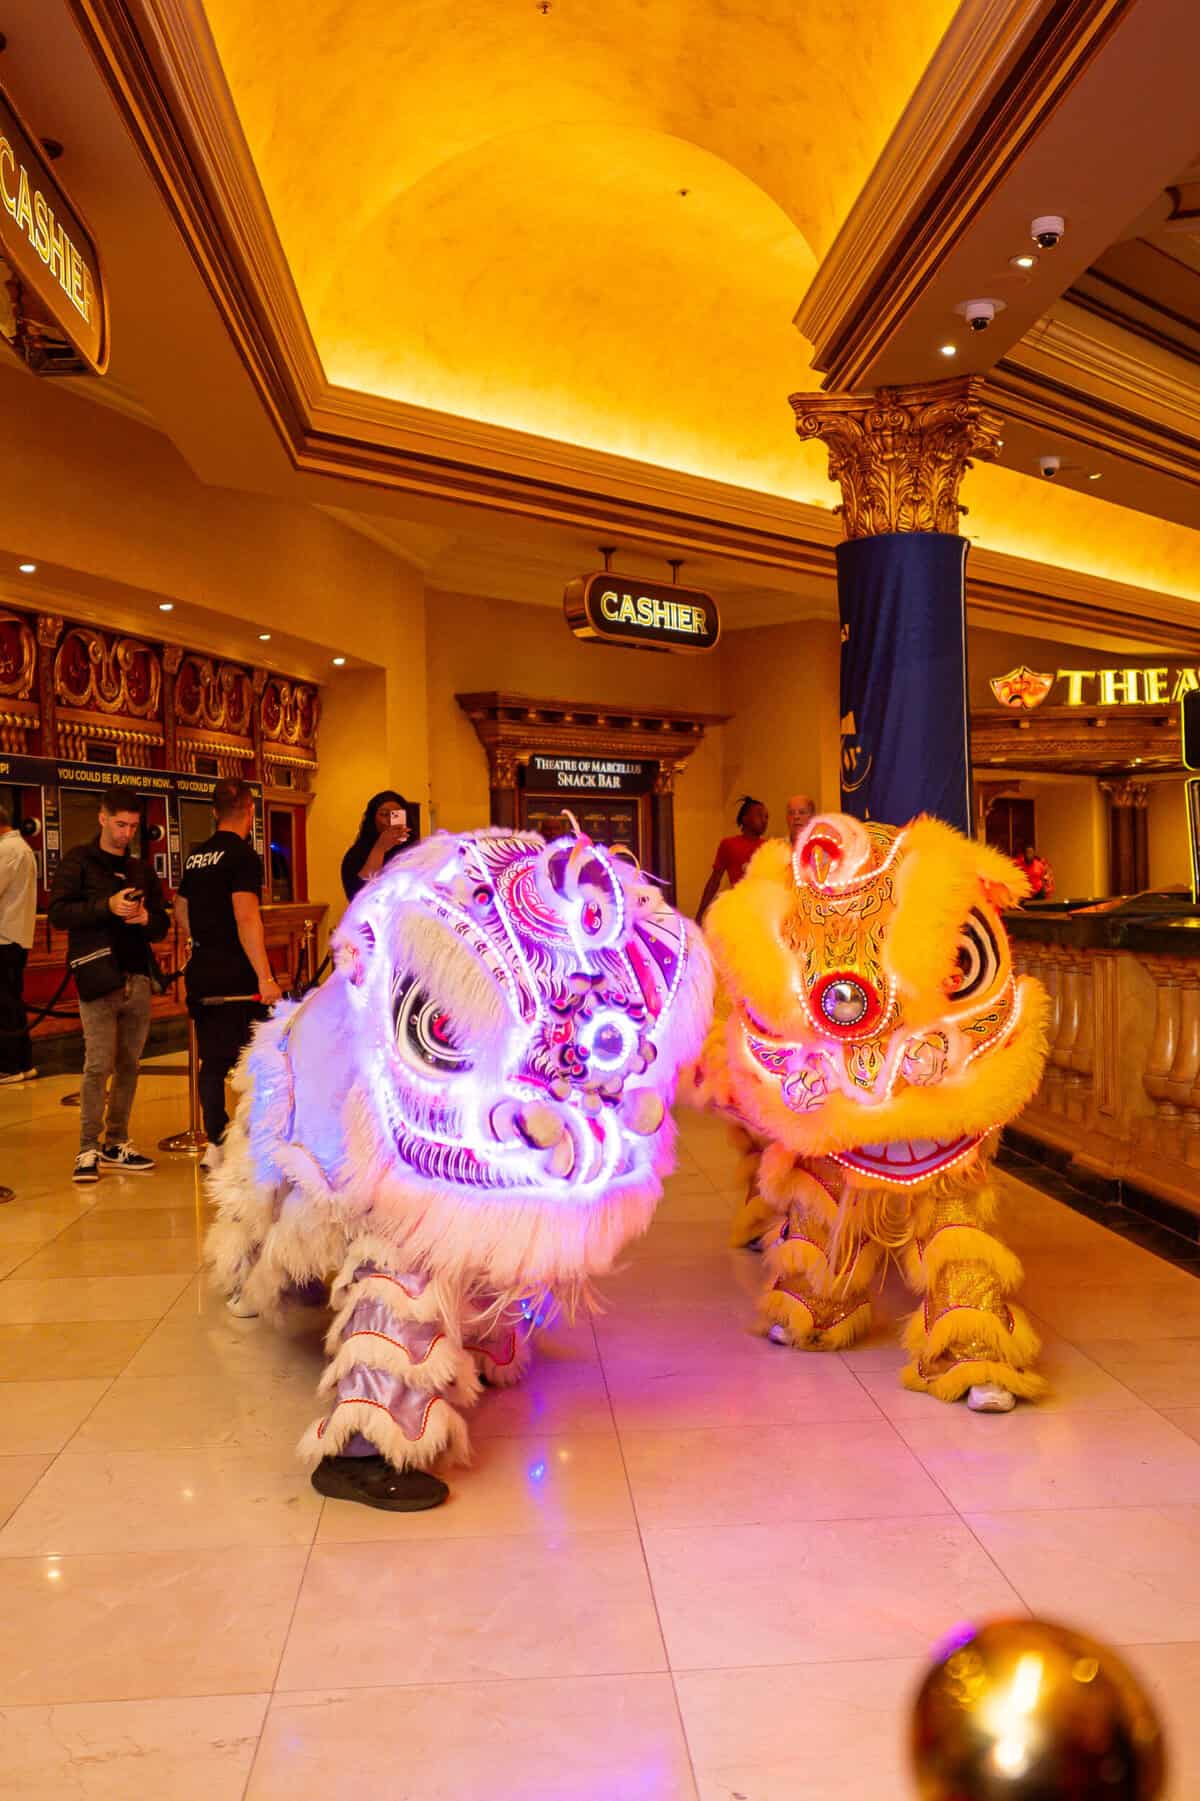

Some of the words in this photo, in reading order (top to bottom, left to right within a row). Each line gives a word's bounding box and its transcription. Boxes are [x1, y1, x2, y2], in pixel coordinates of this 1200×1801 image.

[0, 136, 95, 325] CASHIER
[600, 591, 708, 635] CASHIER
[1056, 668, 1200, 705] THEA
[534, 757, 577, 772] THEATRE
[578, 761, 591, 772] OF
[591, 760, 642, 774] MARCELLUS
[57, 767, 74, 780] YOU
[75, 769, 101, 783] COULD
[102, 772, 112, 784] BE
[112, 773, 142, 786] PLAYING
[142, 775, 152, 787] BY
[176, 780, 189, 791] YOU
[189, 781, 209, 792] COULD
[557, 771, 596, 787] SNACK
[598, 773, 621, 788] BAR
[186, 851, 224, 869] CREW
